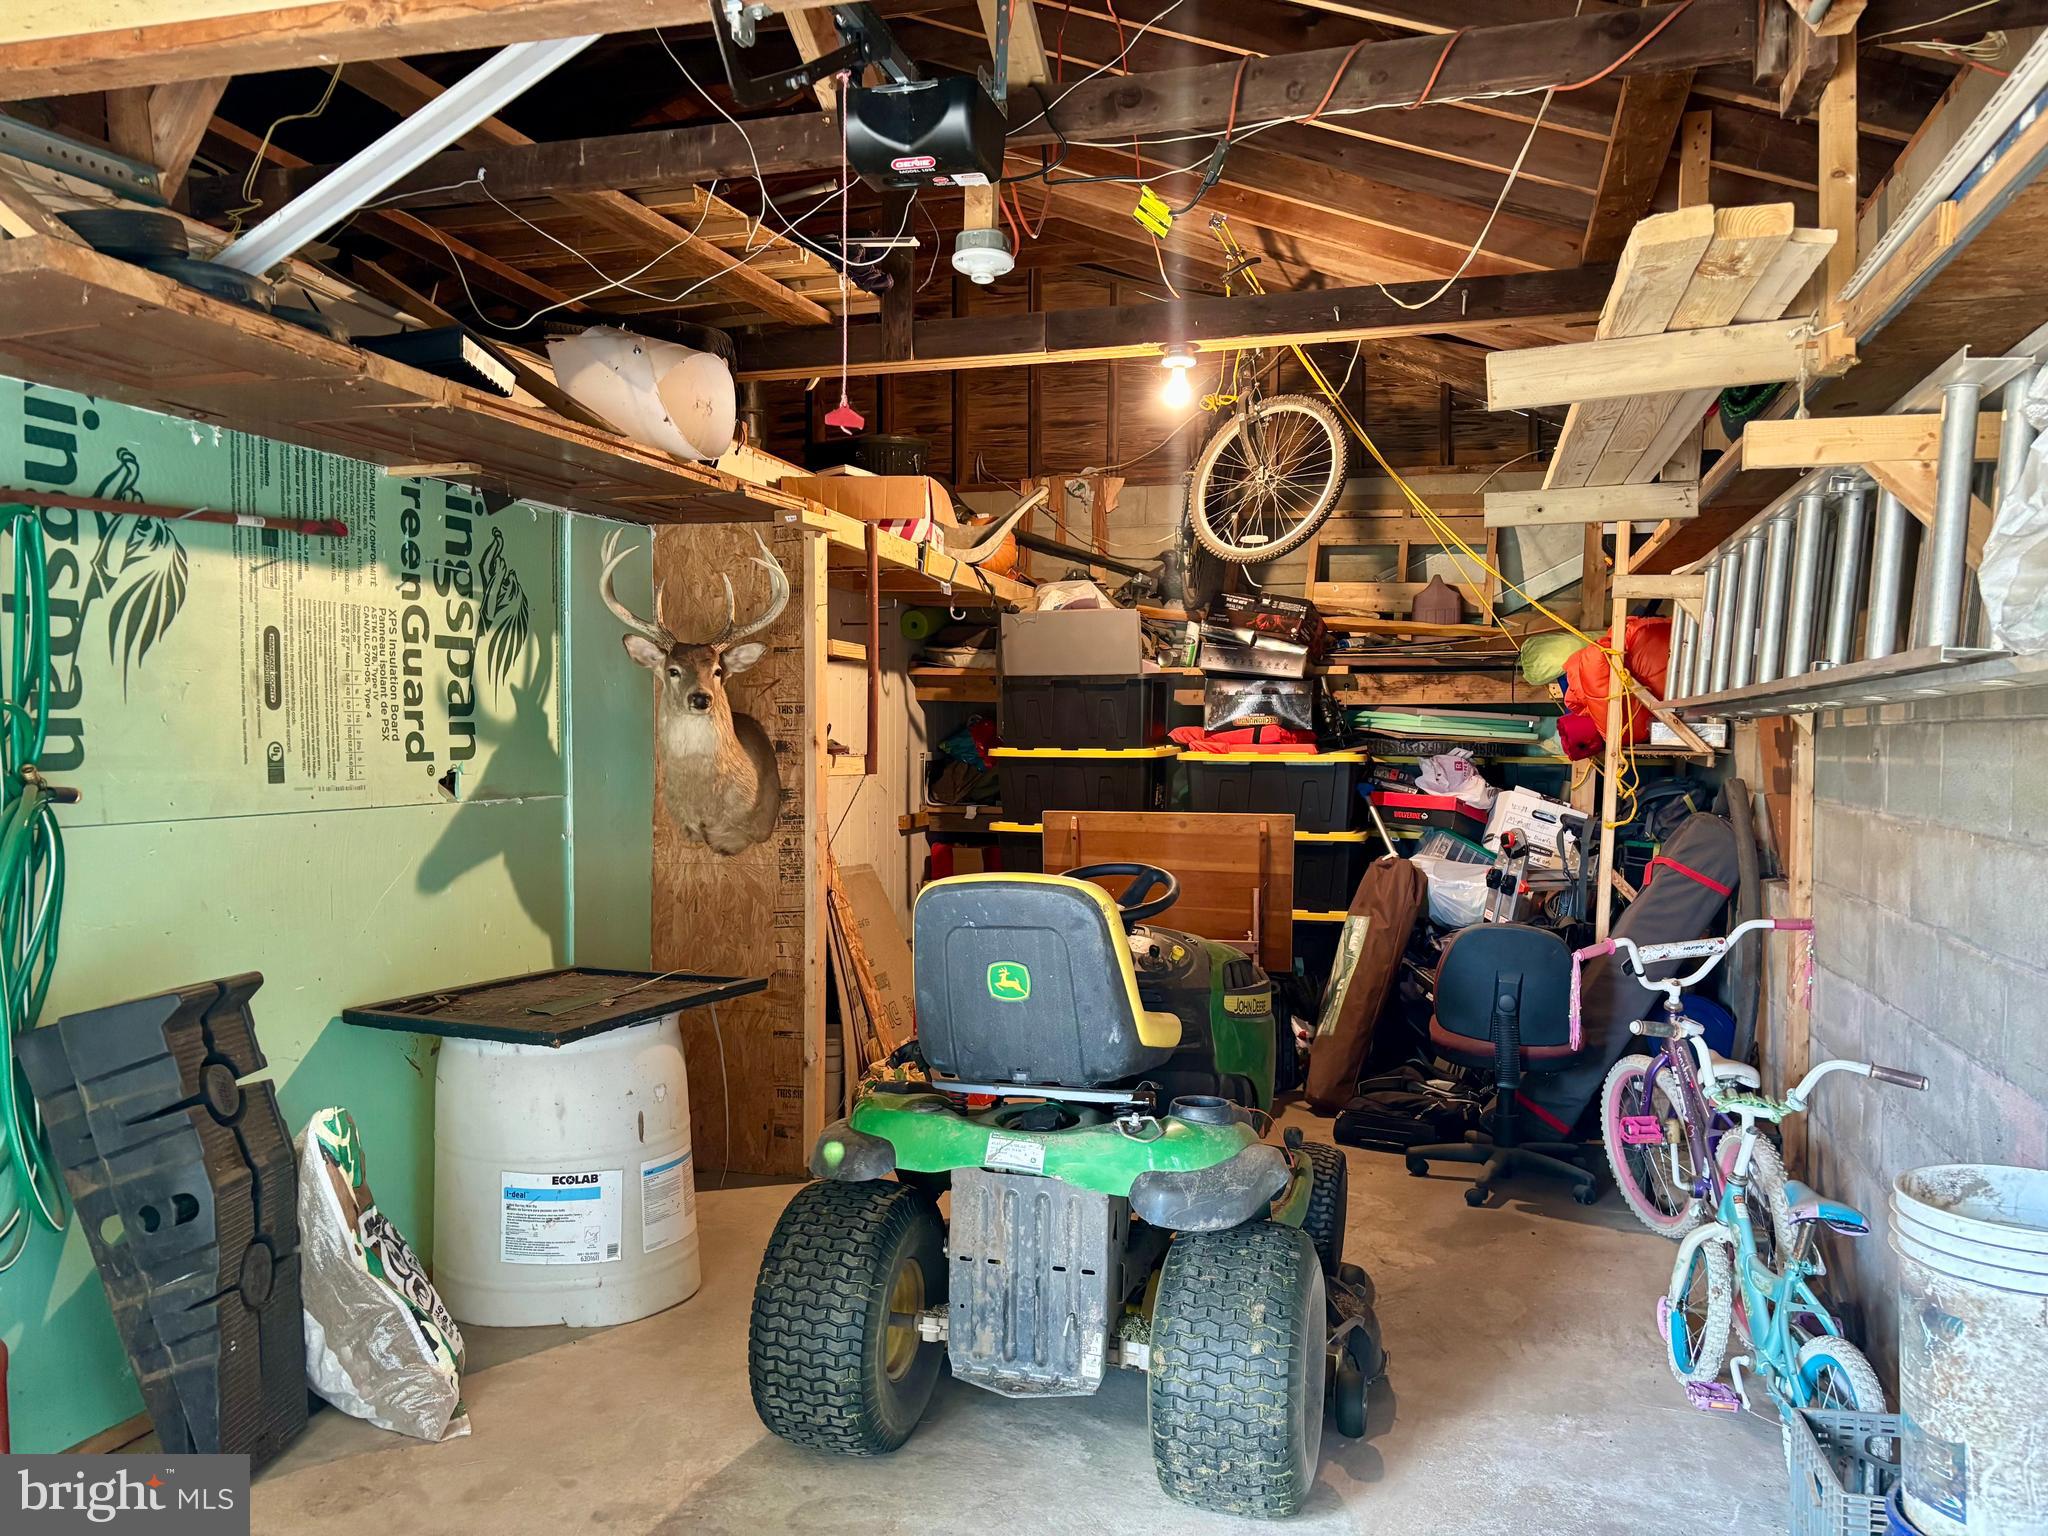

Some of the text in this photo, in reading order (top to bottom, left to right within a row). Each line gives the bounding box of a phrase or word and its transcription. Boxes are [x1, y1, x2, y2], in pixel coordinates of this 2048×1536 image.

[370, 529, 378, 588] CONFORMITÉ
[3, 383, 100, 772] ingspan
[434, 483, 484, 761] ingspan
[379, 608, 390, 741] Panneau isolant de PSX
[388, 608, 400, 742] XPS Insulation Board
[364, 688, 372, 709] Type
[373, 691, 378, 700] IV
[271, 747, 280, 758] UL
[1394, 811, 1421, 820] WOLVERINE
[1234, 997, 1266, 1013] JOHN DEERE
[552, 1174, 599, 1185] ECOLAB
